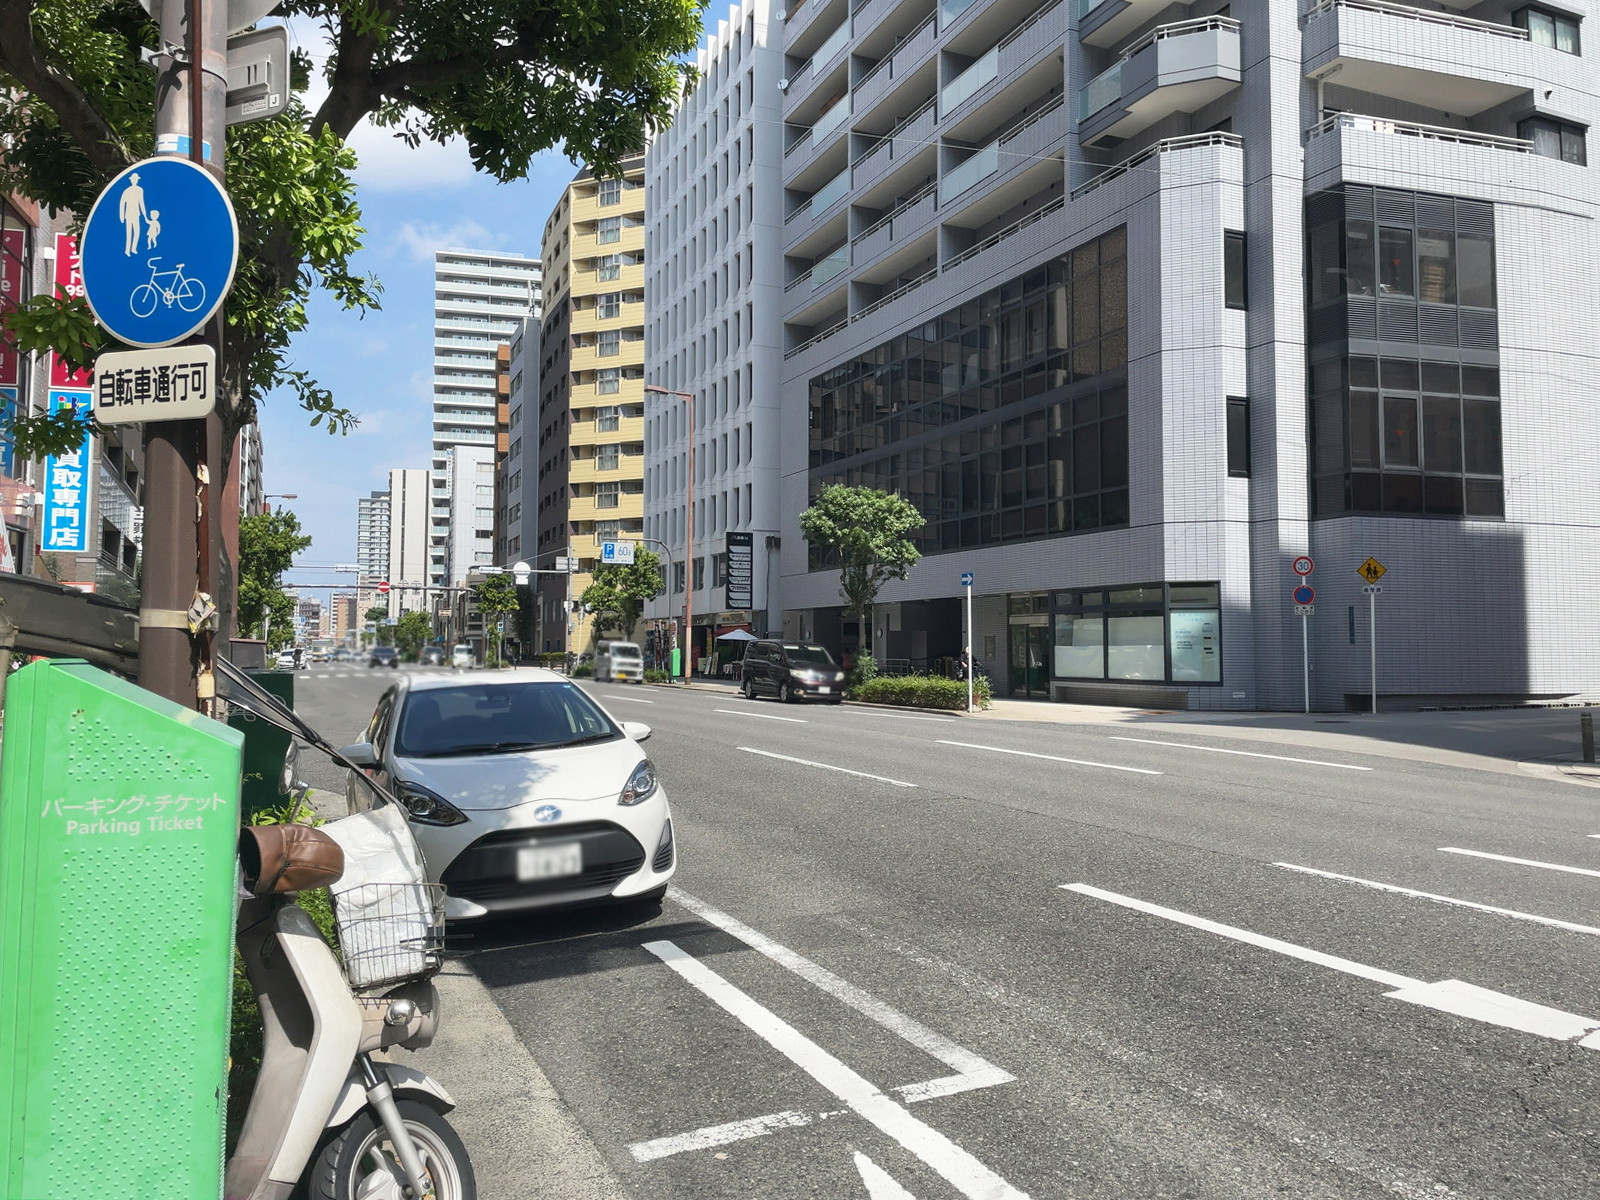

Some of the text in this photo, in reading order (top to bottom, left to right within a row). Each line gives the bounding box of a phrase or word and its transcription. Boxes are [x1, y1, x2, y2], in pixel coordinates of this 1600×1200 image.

[99, 361, 208, 408] 自転車通行可
[48, 448, 82, 547] 買取専門店
[1297, 561, 1310, 572] 30
[41, 792, 227, 817] パーキング・チケット
[66, 816, 203, 836] Parking Ticket
